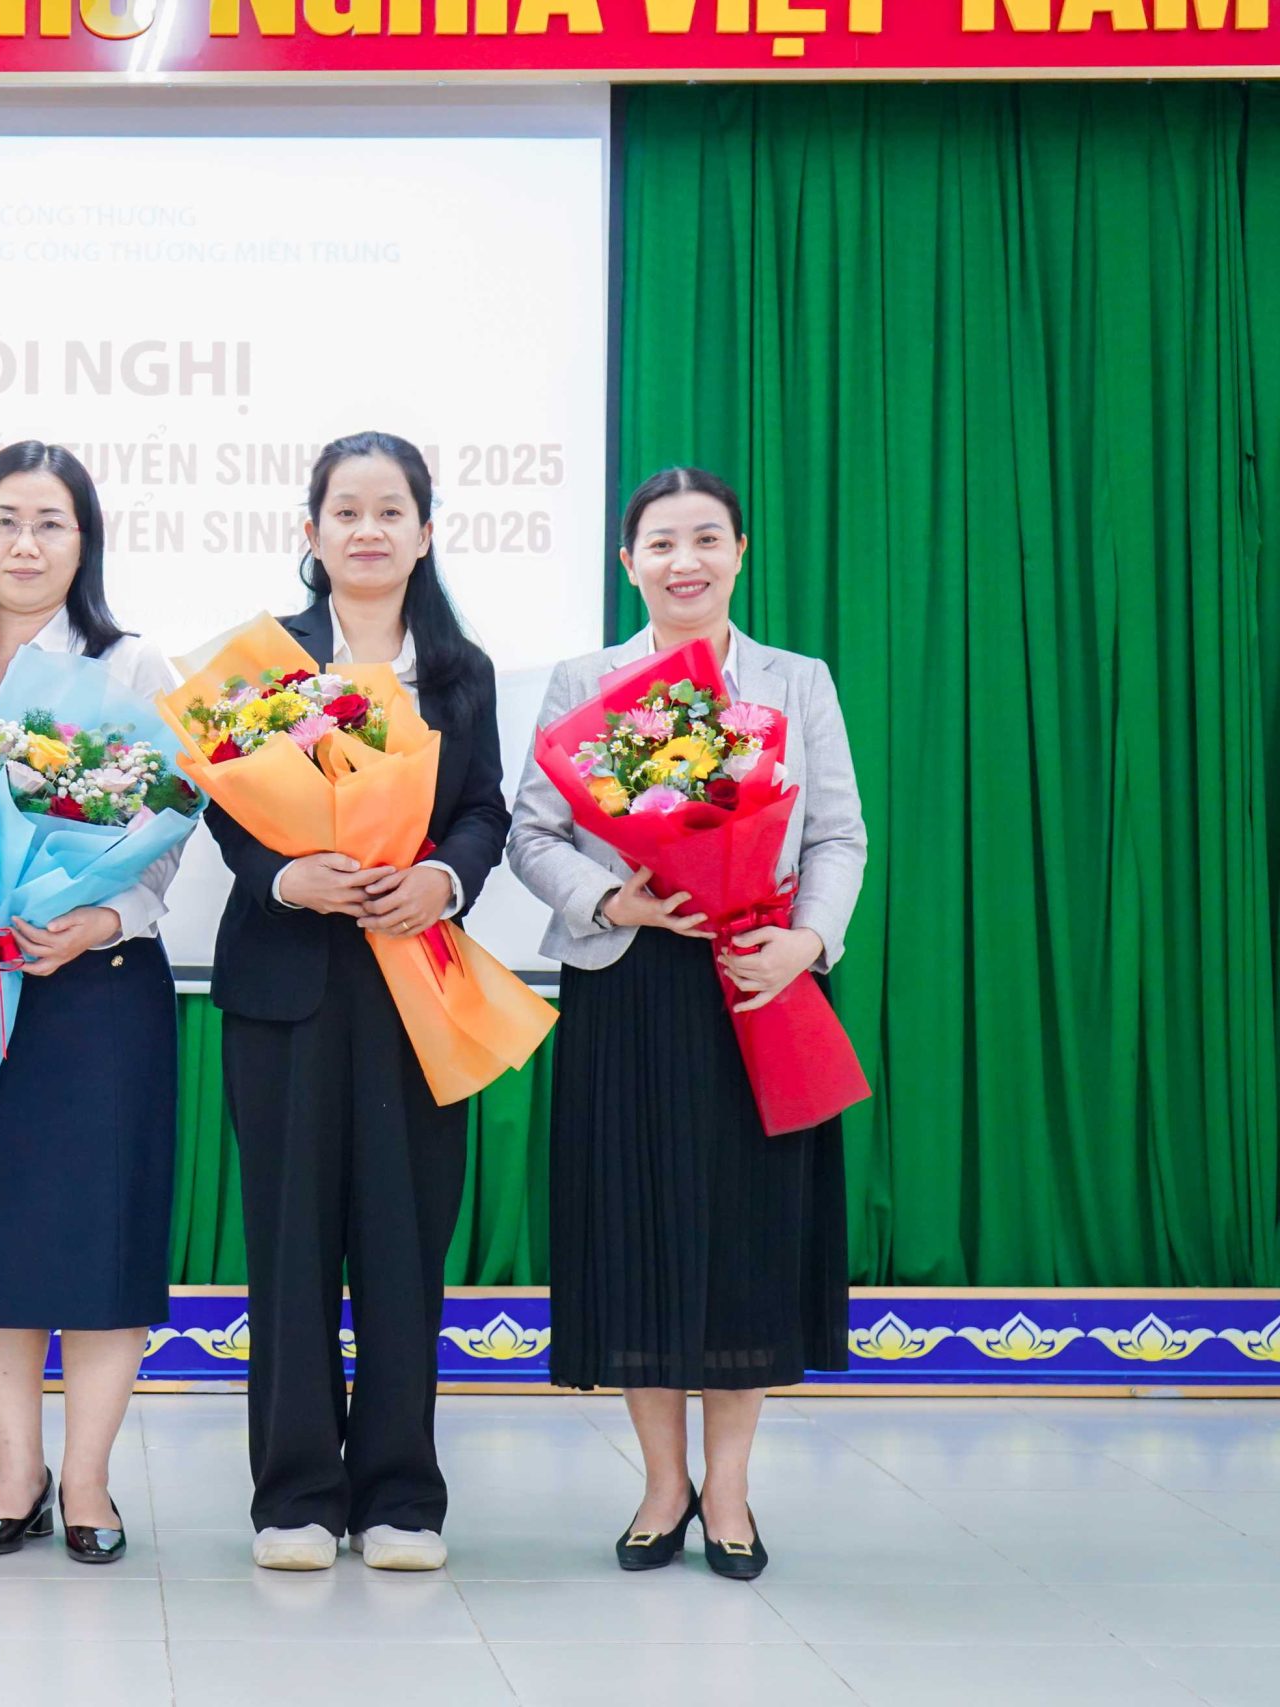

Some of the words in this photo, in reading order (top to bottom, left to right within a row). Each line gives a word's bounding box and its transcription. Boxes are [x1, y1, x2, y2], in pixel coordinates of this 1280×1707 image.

[308, 239, 401, 264] TRUNG
[64, 339, 251, 415] NGHỊ
[458, 443, 564, 486] 2025
[446, 510, 552, 554] 2026
